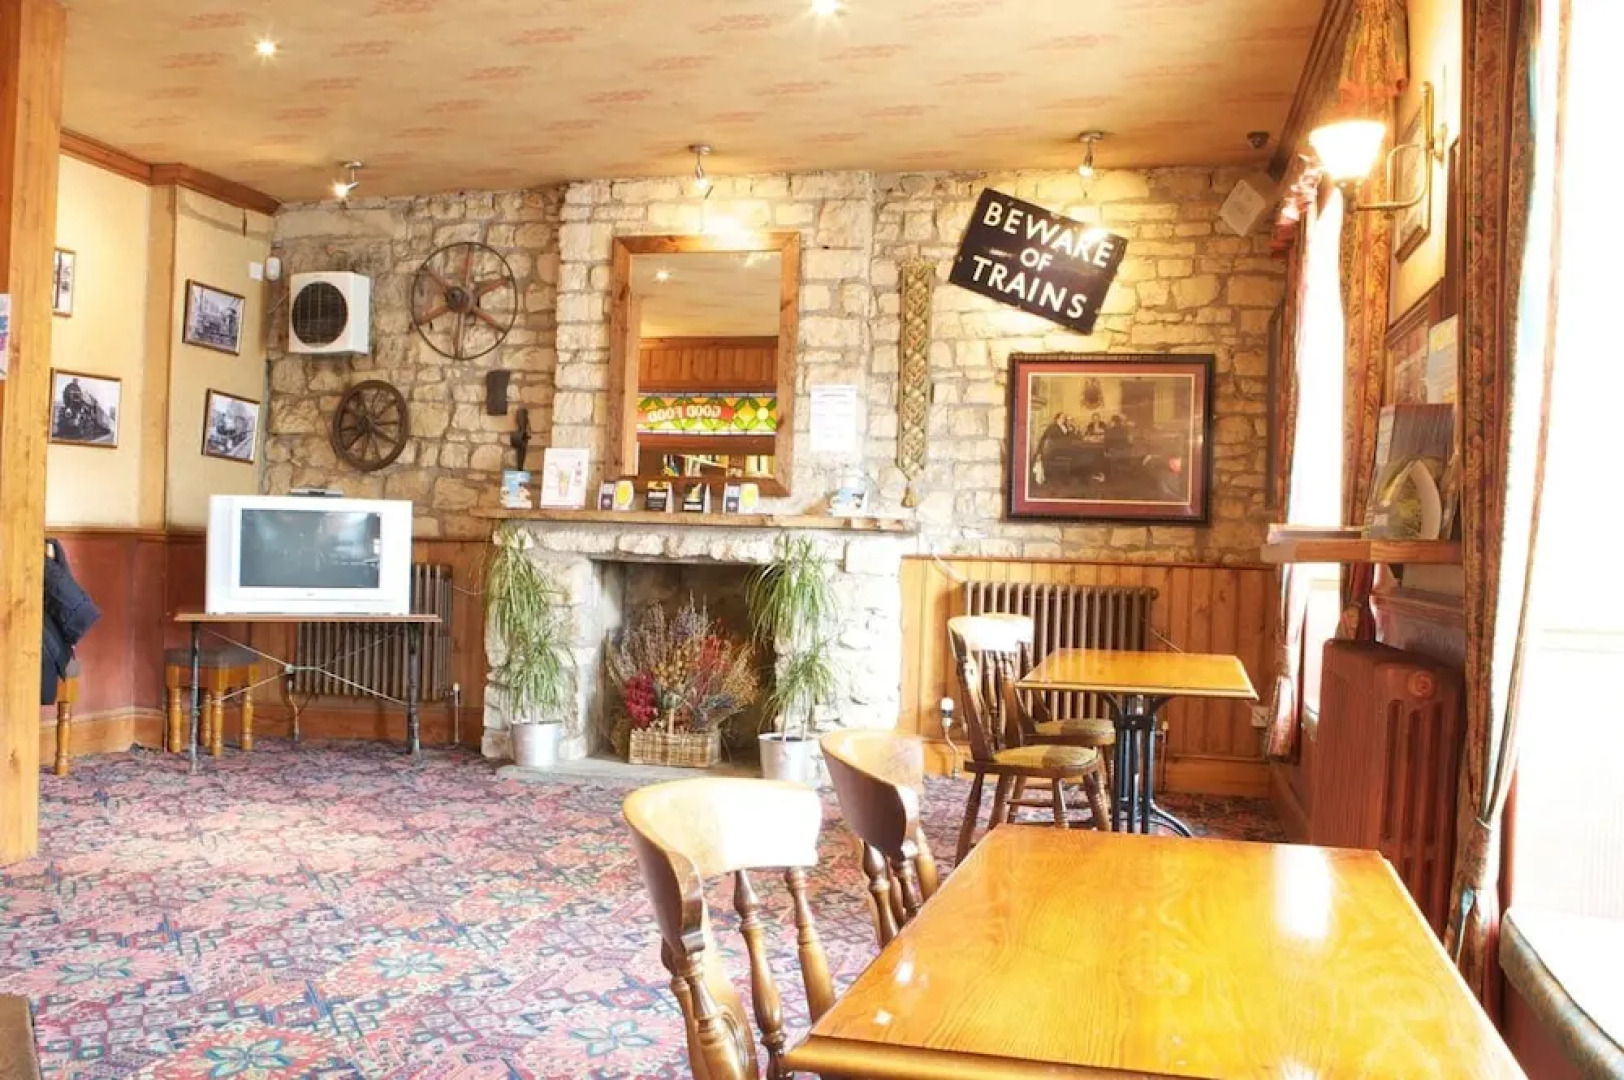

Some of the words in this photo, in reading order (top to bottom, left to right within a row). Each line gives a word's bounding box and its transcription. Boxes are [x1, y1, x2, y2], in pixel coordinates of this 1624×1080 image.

[983, 202, 1114, 268] BEWARE
[1020, 247, 1053, 271] OF
[972, 255, 1088, 319] TRAINS
